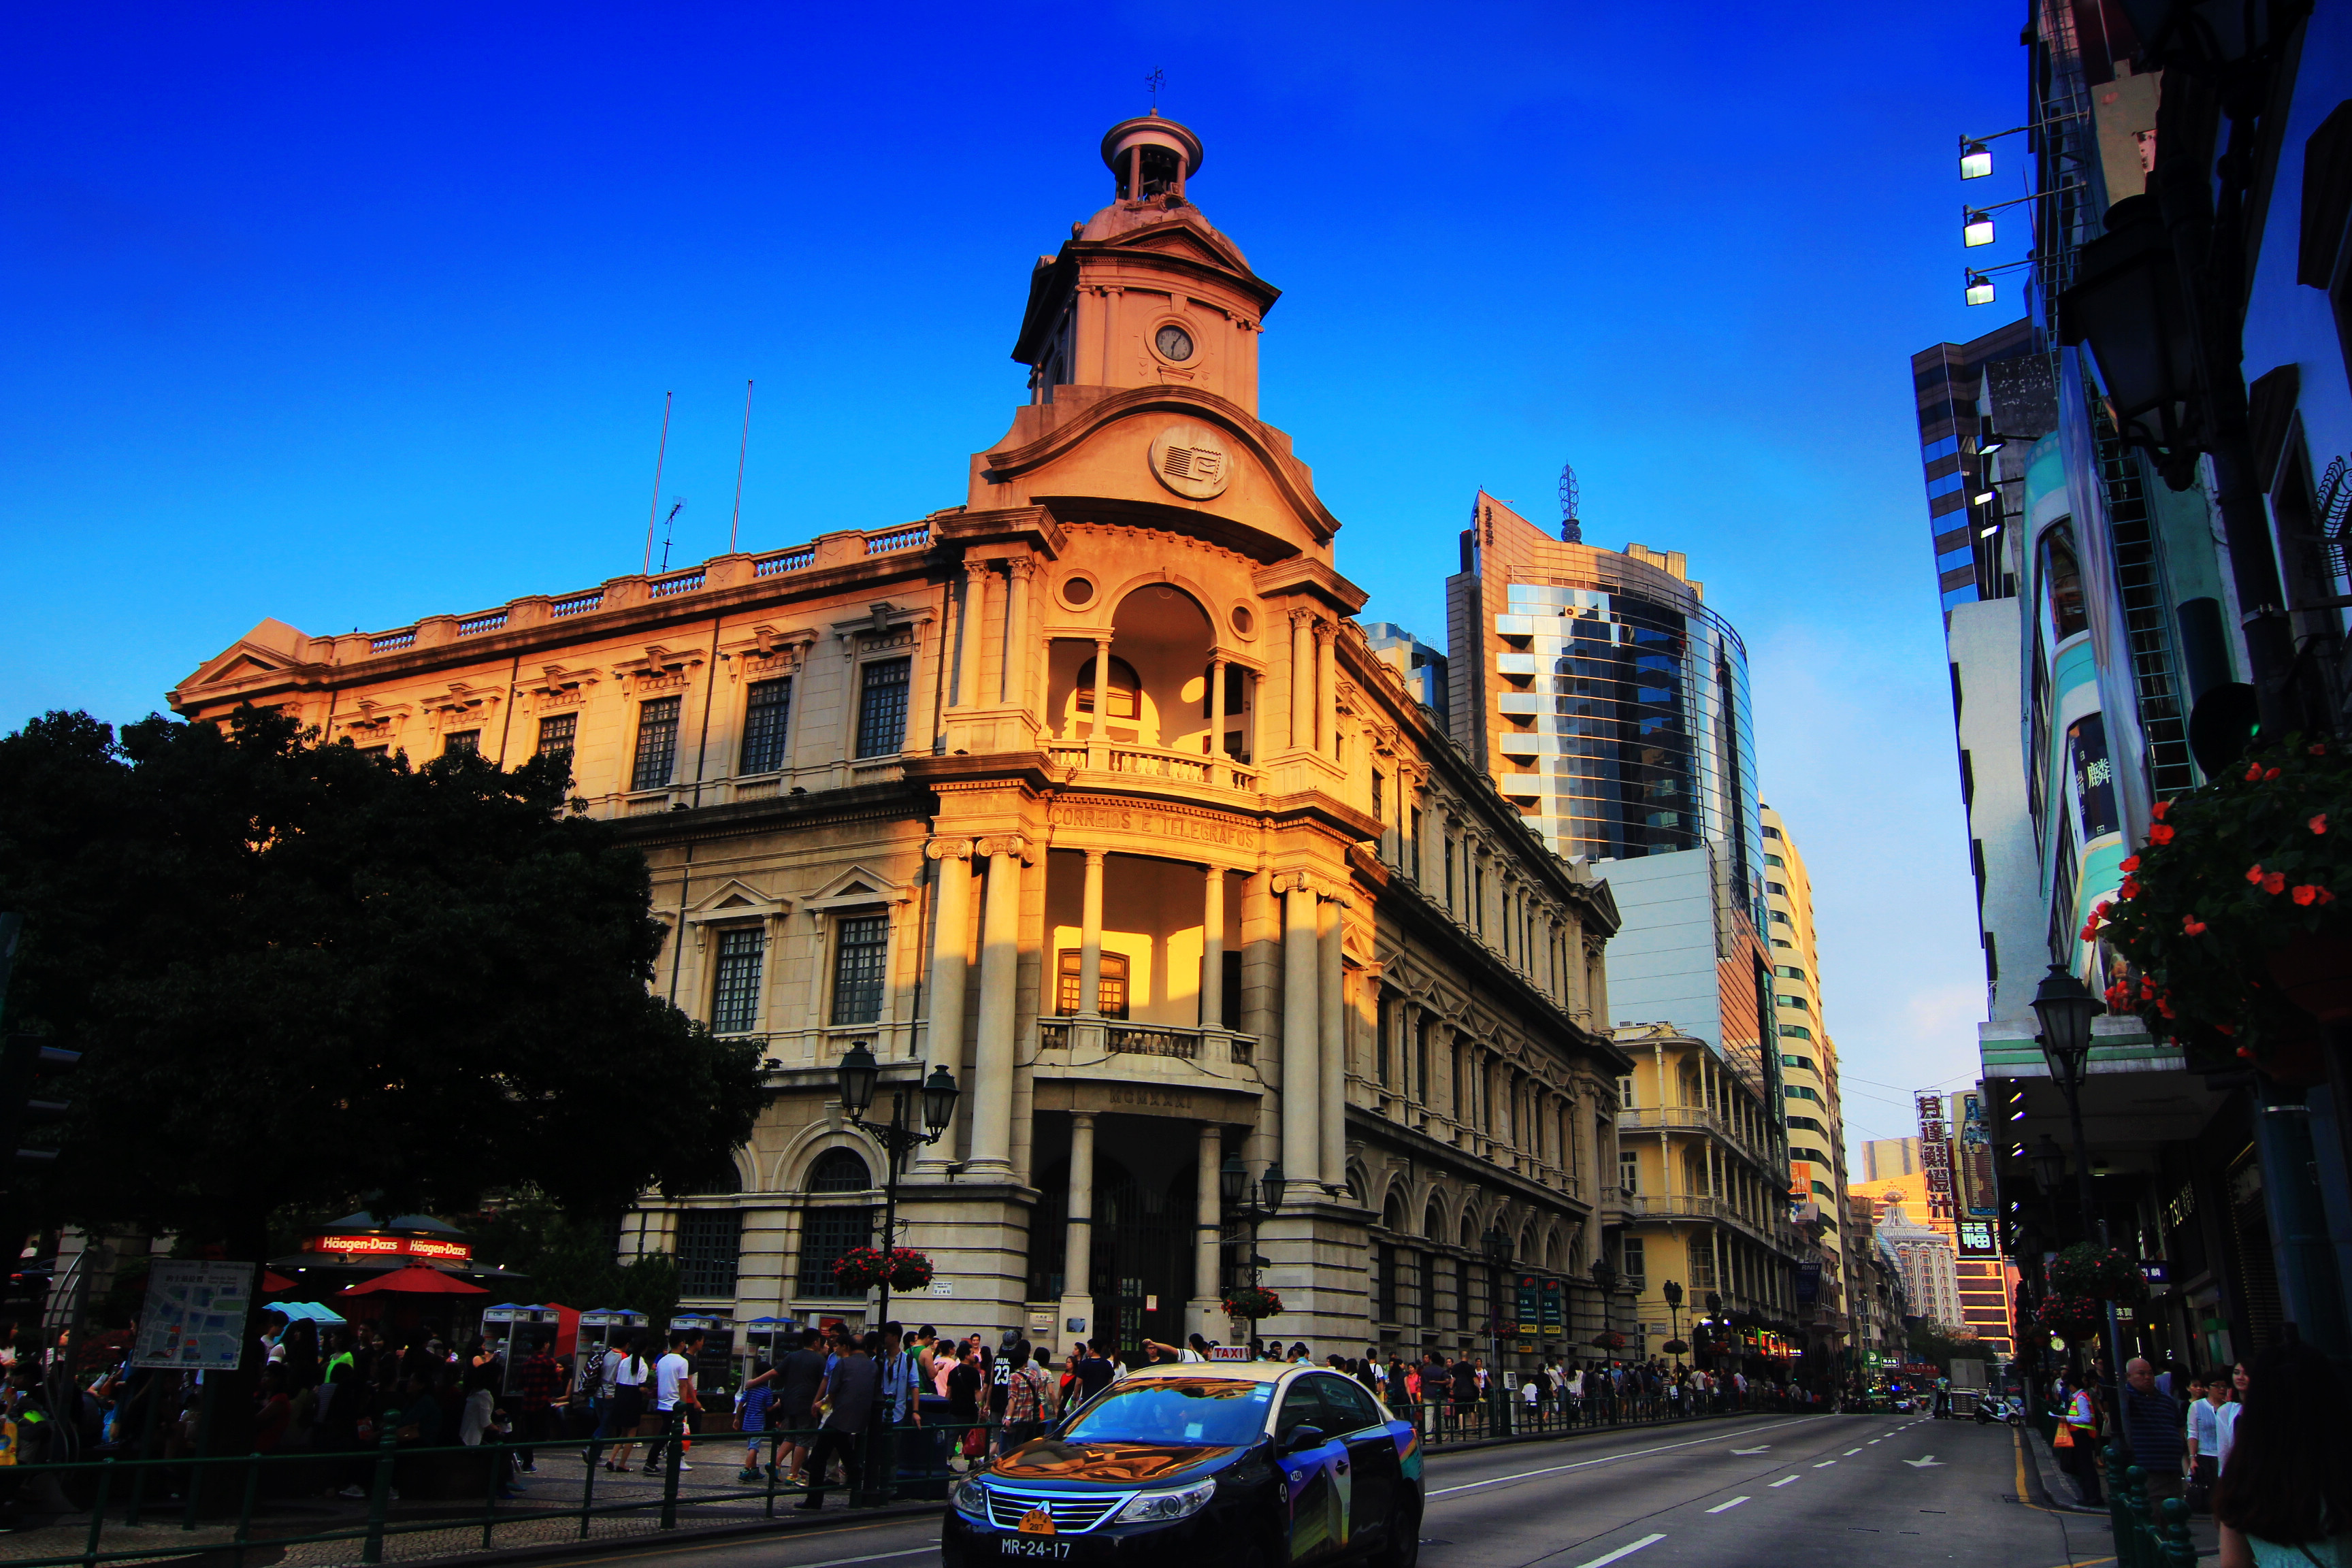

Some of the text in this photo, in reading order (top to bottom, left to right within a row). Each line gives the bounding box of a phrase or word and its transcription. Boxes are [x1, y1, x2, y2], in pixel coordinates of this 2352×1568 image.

[1051, 808, 1254, 848] CORREIOS E TELEGRAFOS
[1110, 1089, 1191, 1109] MCMXXXI
[1918, 1096, 1953, 1218] 芬達鮮橙汁
[323, 1237, 398, 1252] Häagen-Dazs
[1961, 1222, 1991, 1249] 福
[410, 1240, 466, 1256] Häagen-Dazs
[1214, 1348, 1243, 1358] TAXI
[994, 1365, 1010, 1385] 23
[1029, 1523, 1044, 1531] 297
[1001, 1538, 1071, 1558] MR-24-17
